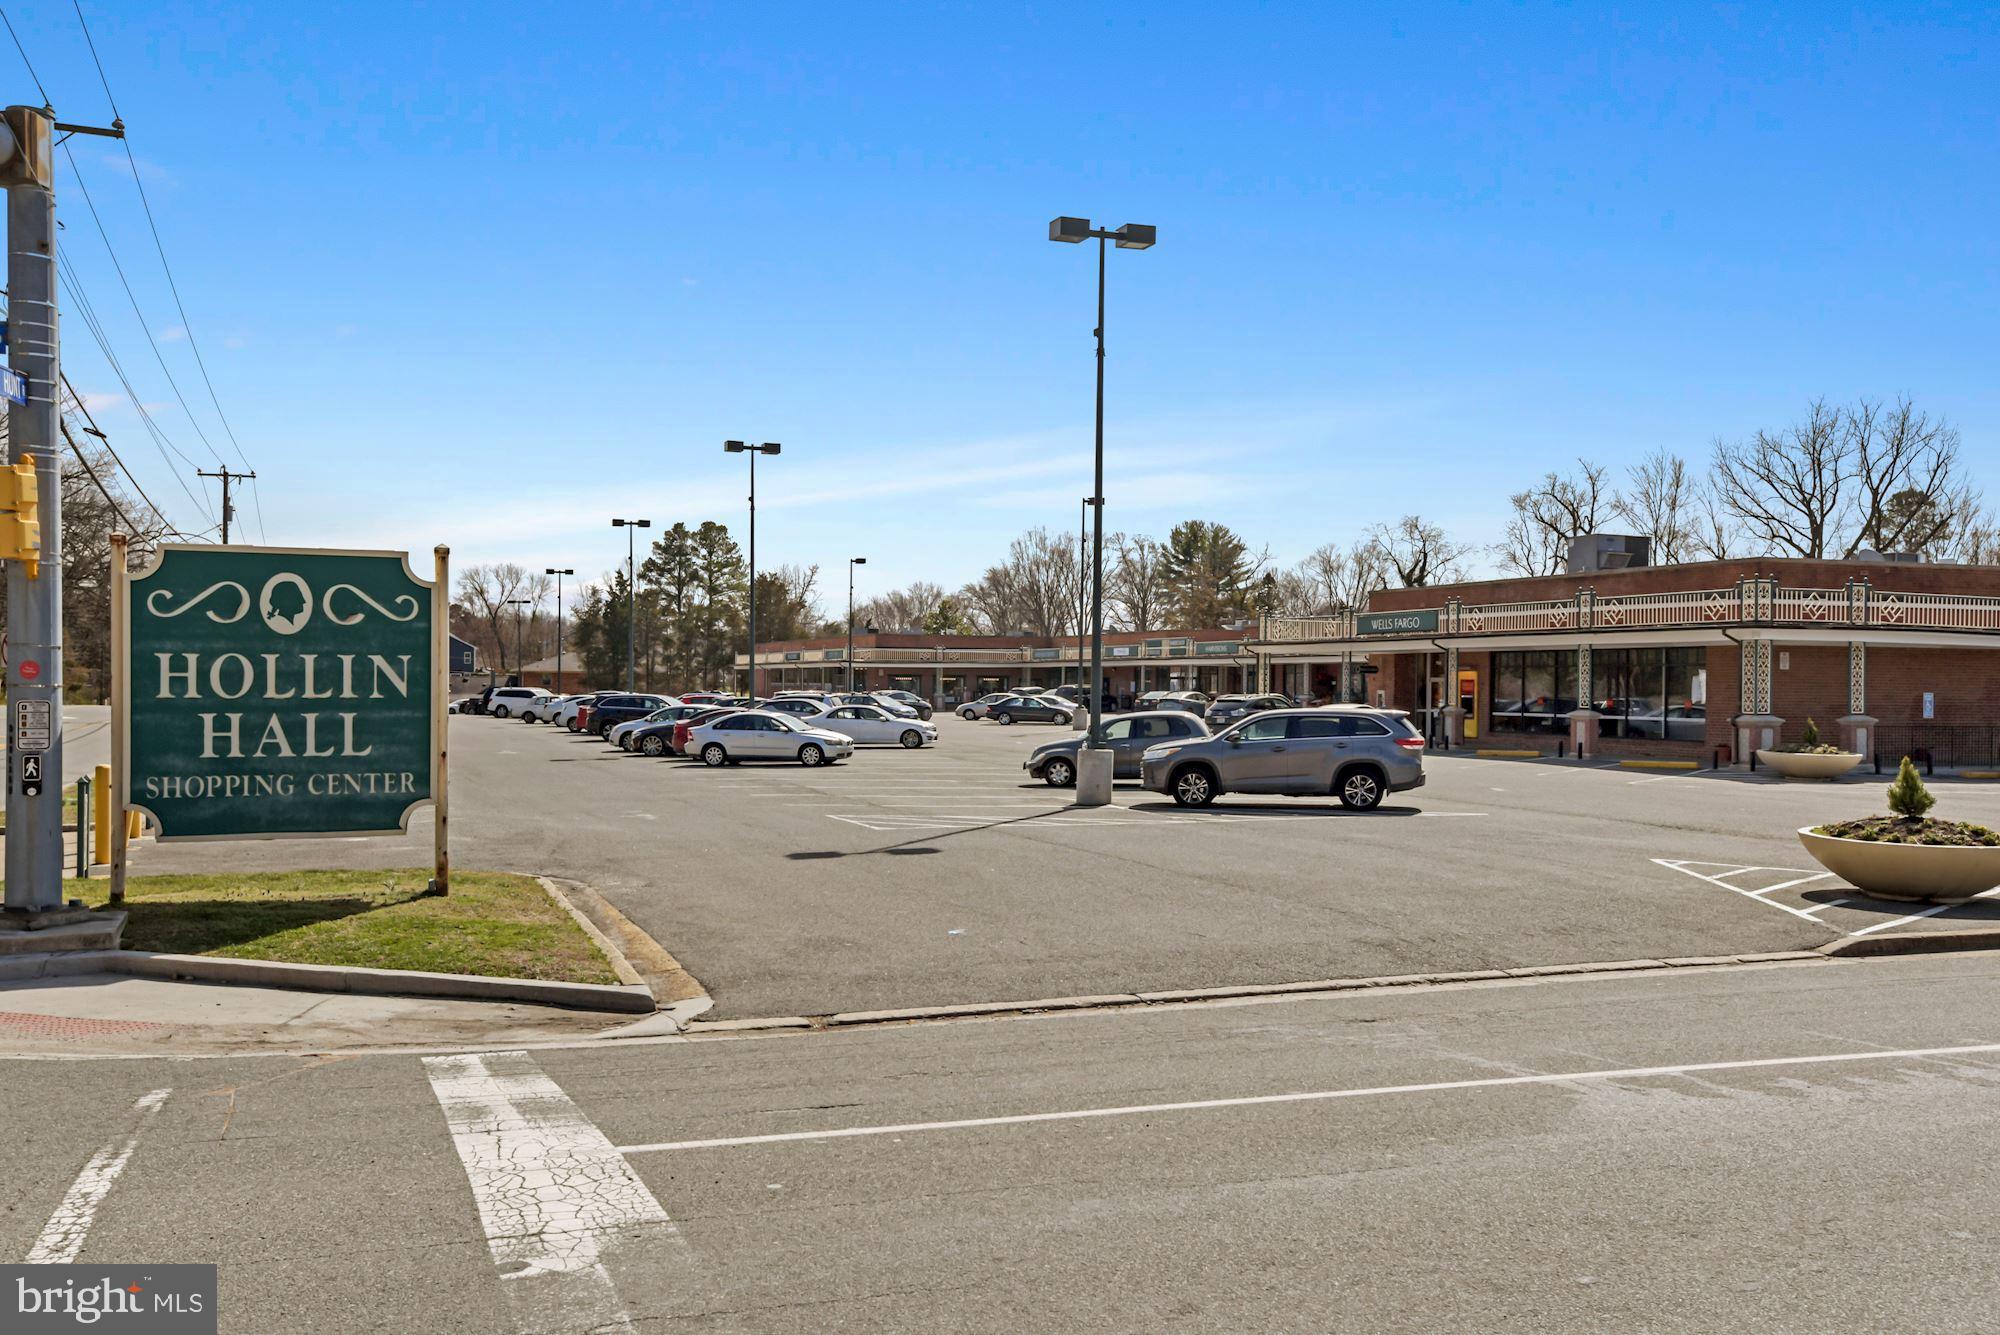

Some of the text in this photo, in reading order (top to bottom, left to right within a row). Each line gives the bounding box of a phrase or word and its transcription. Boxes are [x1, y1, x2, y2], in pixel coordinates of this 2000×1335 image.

[3, 371, 21, 398] HUNT
[1371, 616, 1420, 630] WELLS FARGO
[153, 652, 412, 700] HOLLIN
[197, 712, 373, 758] HALL
[145, 771, 416, 799] SHOPPING CENTER
